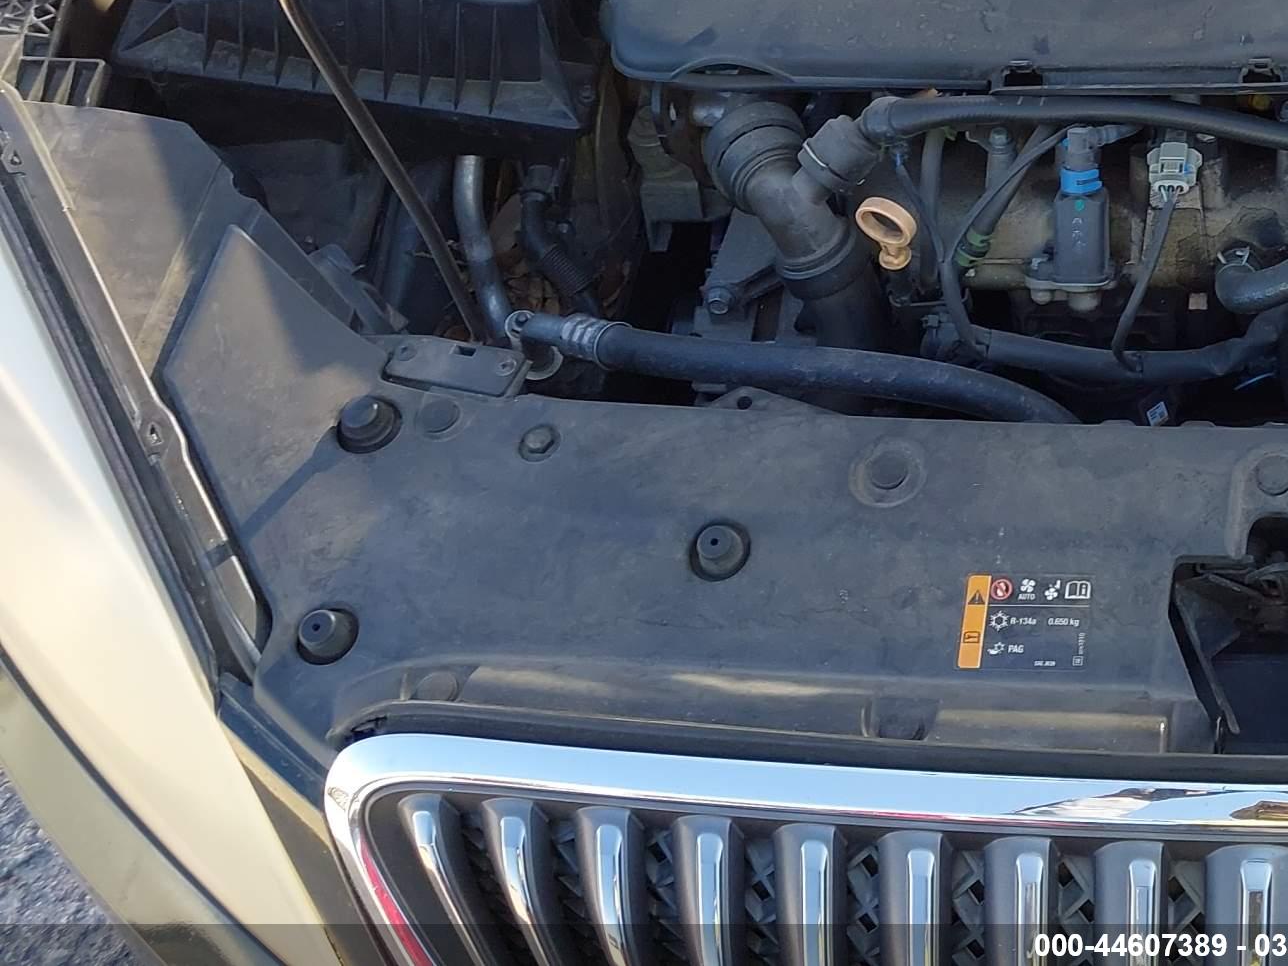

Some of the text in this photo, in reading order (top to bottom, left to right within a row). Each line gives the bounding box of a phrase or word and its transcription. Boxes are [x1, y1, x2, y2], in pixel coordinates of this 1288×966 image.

[1018, 593, 1036, 601] AUTO
[1010, 617, 1037, 625] R-134a
[1048, 617, 1080, 627] 0.650 kg
[1007, 644, 1025, 653] PAG
